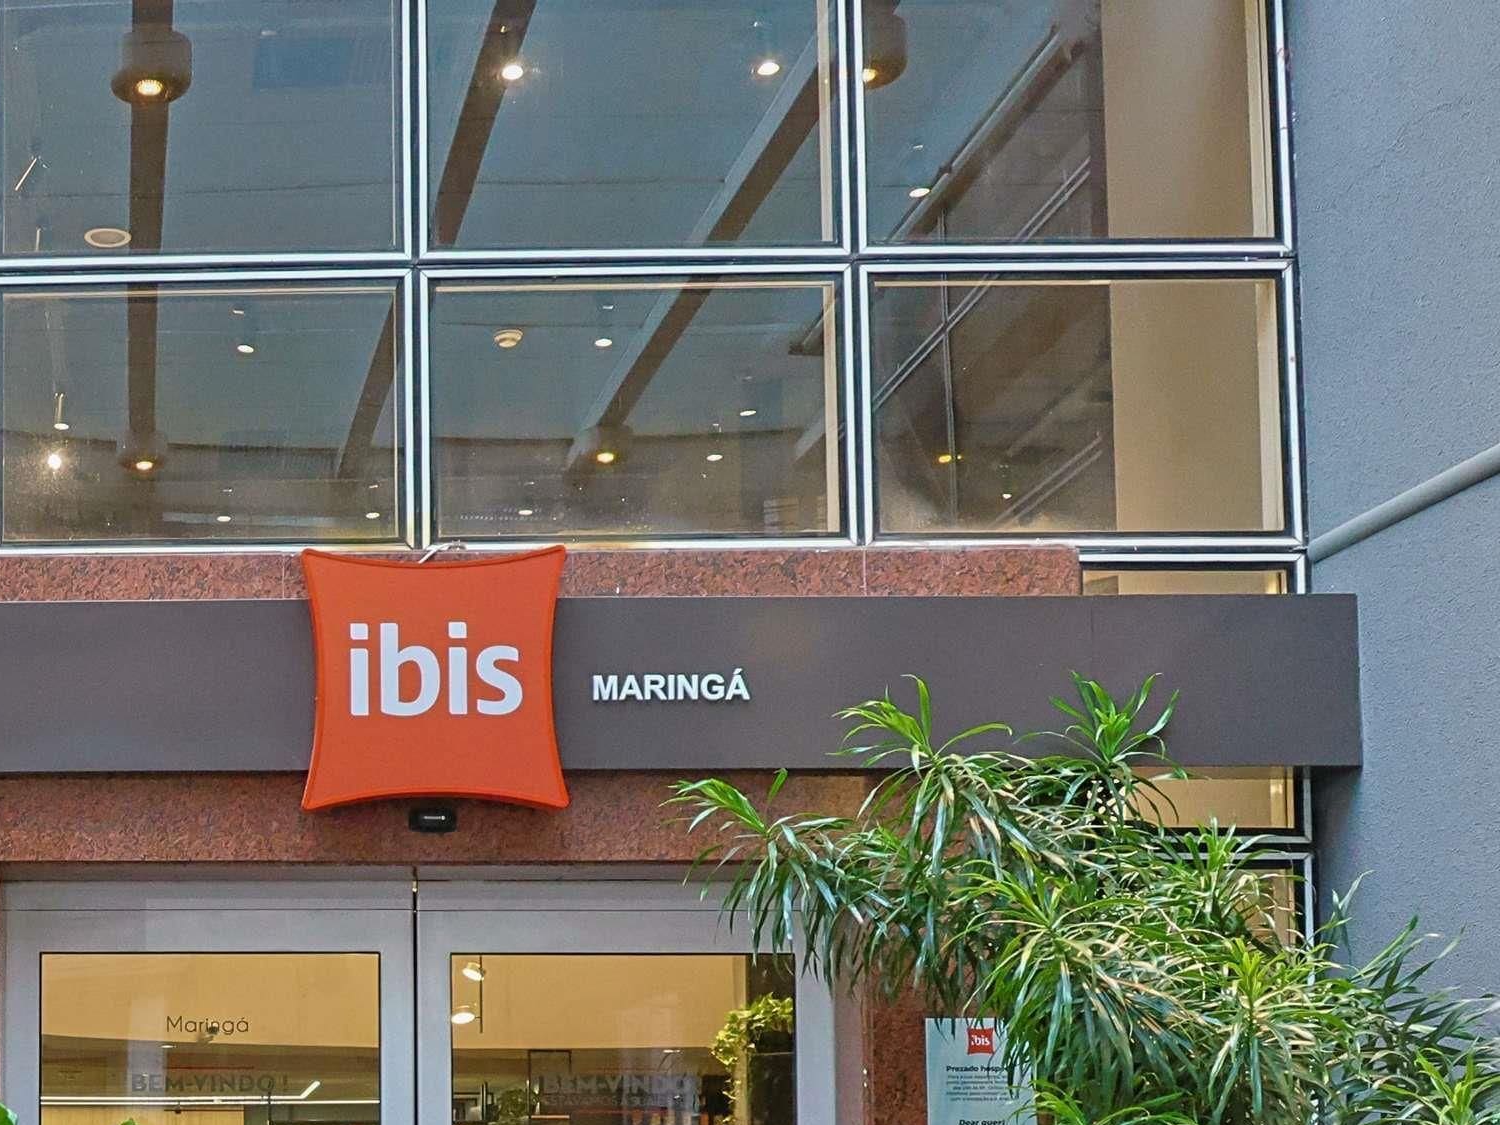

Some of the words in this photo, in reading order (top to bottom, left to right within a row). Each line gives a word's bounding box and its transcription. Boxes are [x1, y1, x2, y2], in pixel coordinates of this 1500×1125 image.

[349, 621, 523, 717] ibis
[592, 667, 750, 701] MARINGÁ
[166, 1015, 249, 1036] Maringá
